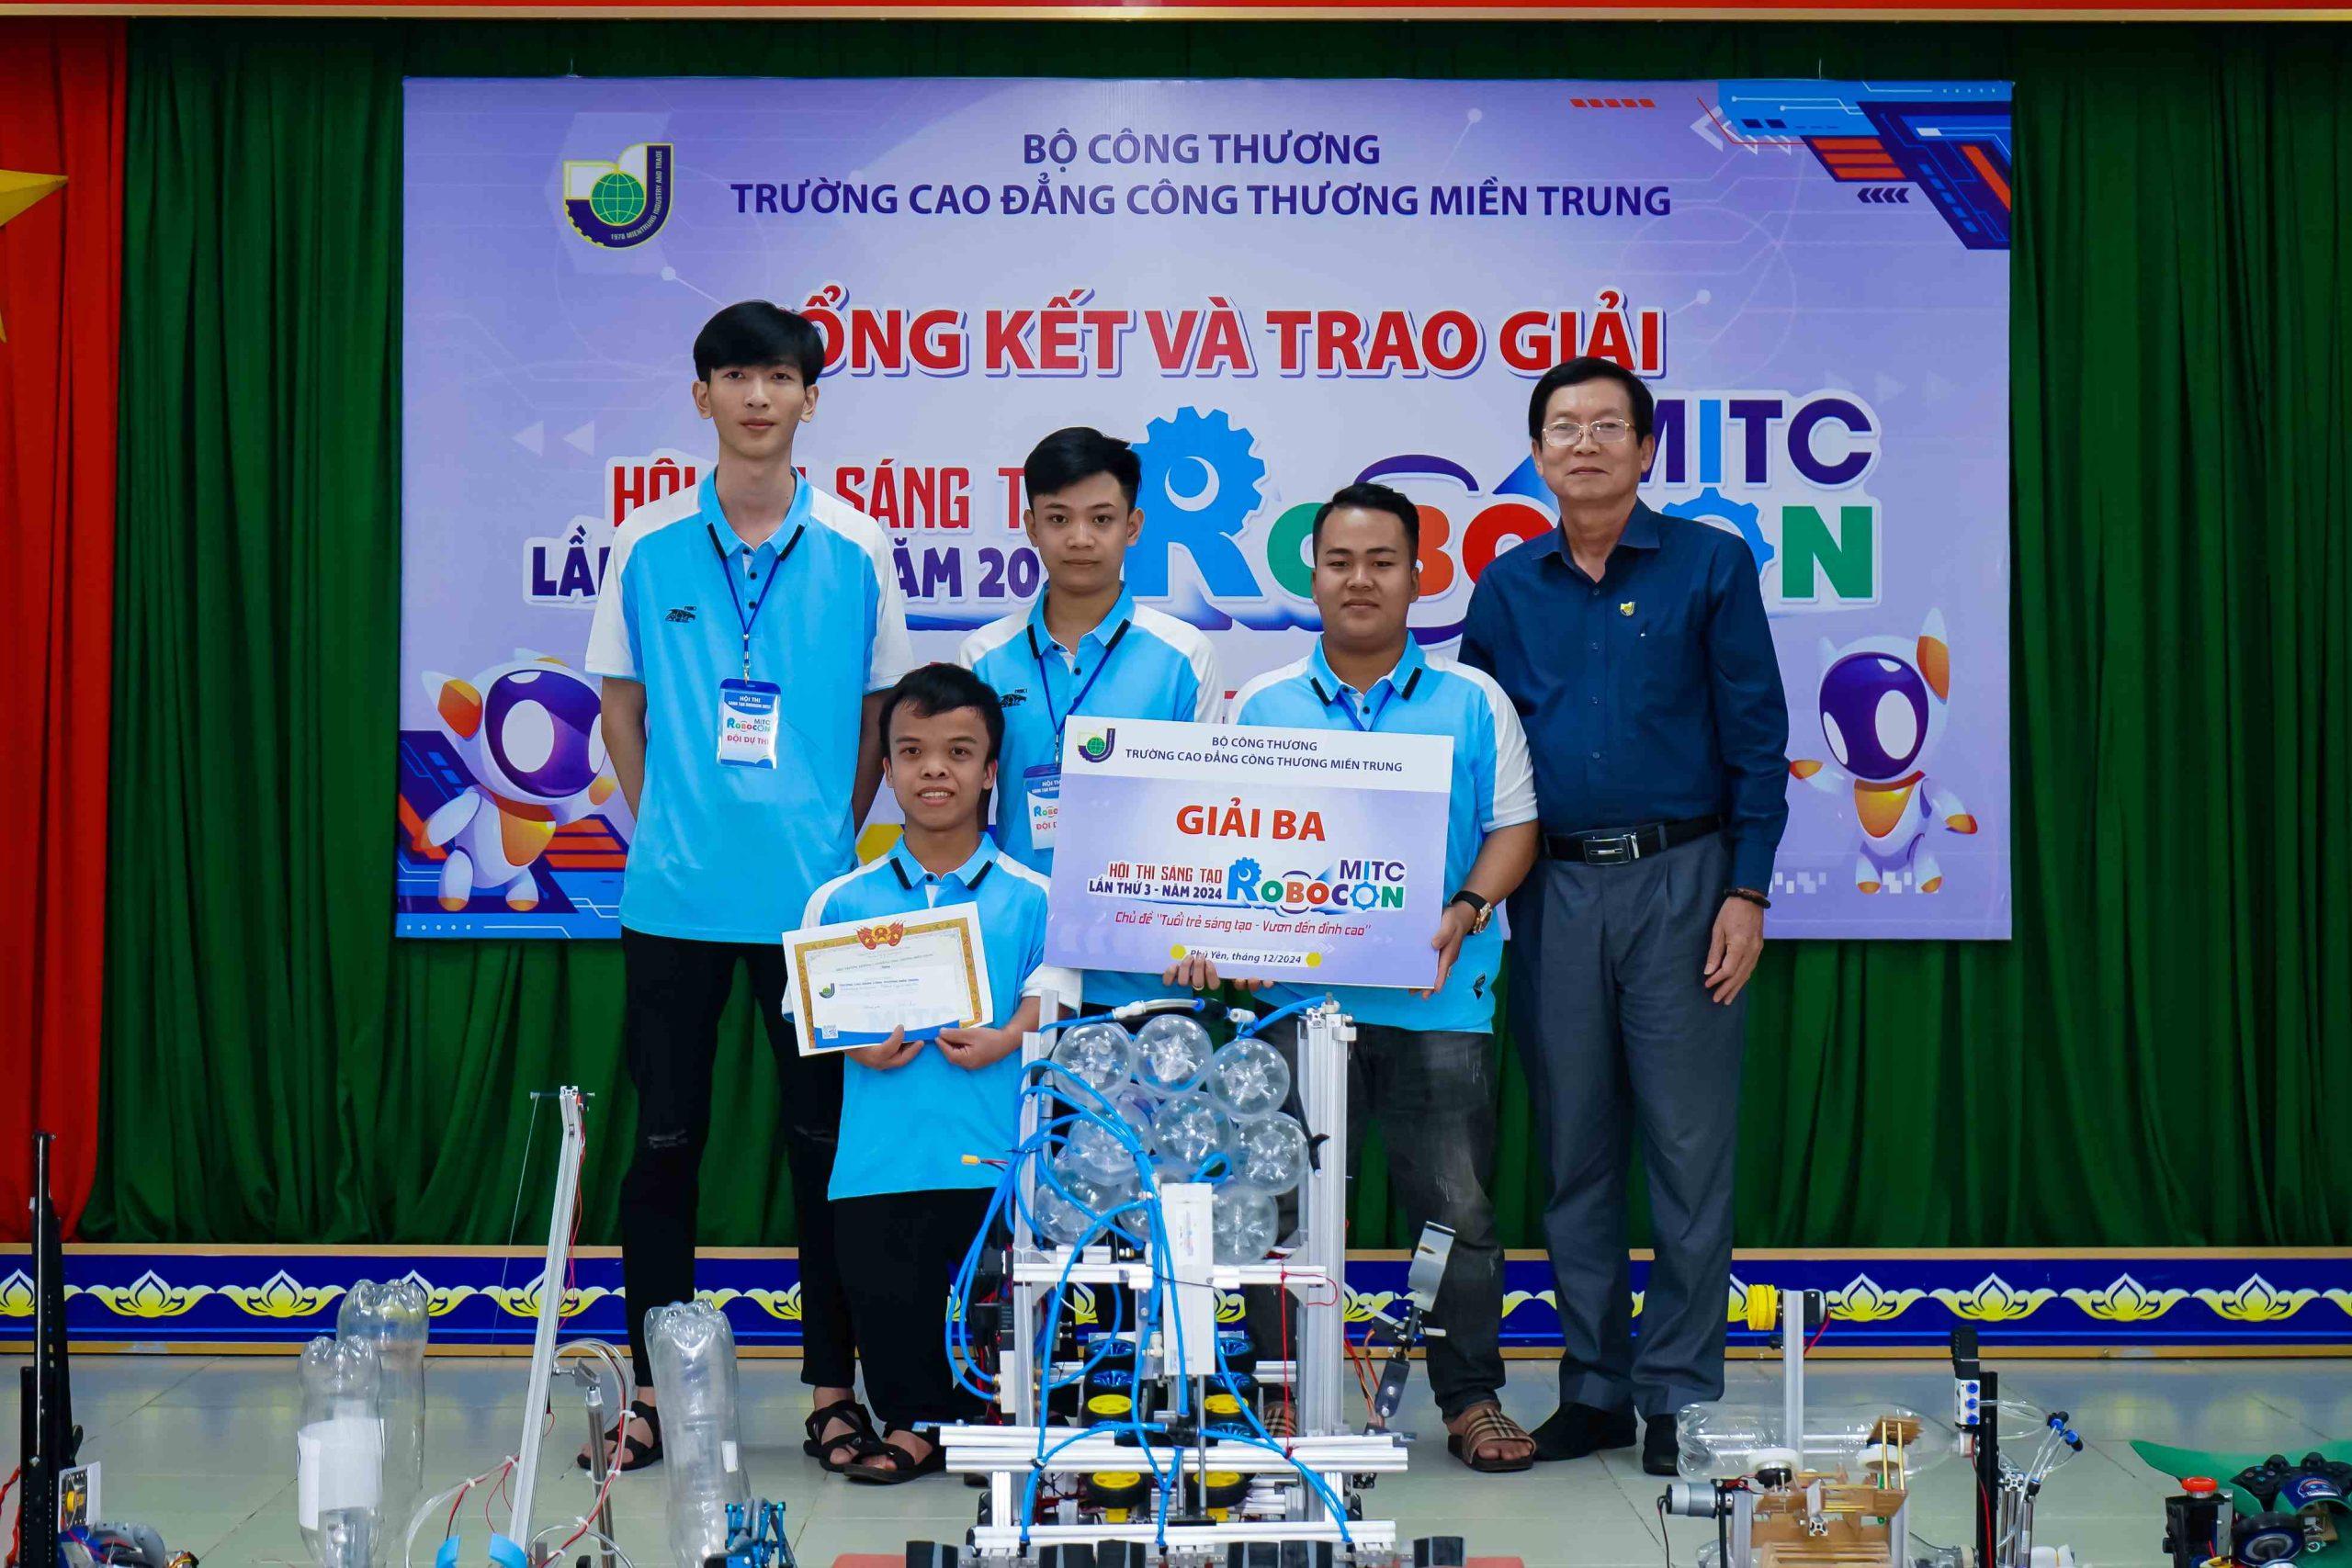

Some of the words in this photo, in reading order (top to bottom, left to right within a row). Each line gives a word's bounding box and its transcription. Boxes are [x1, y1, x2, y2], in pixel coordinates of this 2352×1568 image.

[1023, 127, 1078, 174] BỘ
[1088, 127, 1200, 164] CÔNG
[1208, 129, 1380, 165] THƯƠNG
[730, 175, 899, 214] TRƯỜNG
[909, 183, 991, 215] CAO
[1000, 171, 1115, 216] ĐẲNG
[1126, 177, 1238, 216] CÔNG
[1247, 180, 1419, 217] THƯƠNG
[1430, 175, 1528, 217] MIỀN
[1536, 185, 1672, 218] TRUNG
[796, 284, 962, 371] ỔNG
[986, 288, 1128, 370] KẾT
[1144, 295, 1250, 370] VÀ
[1266, 309, 1479, 372] TRAO
[1498, 289, 1658, 372] GIẢI
[836, 458, 970, 529] SÁNG
[532, 525, 612, 598] LẦ
[891, 536, 963, 598] ĂM
[978, 547, 1040, 598] 20
[1212, 736, 1228, 750] BỘ
[1231, 738, 1264, 749] CÔNG
[1267, 739, 1317, 751] THƯƠNG
[1125, 749, 1174, 761] TRƯỜNG
[1177, 751, 1202, 761] CAO
[1241, 754, 1274, 766] CÔNG
[1277, 757, 1328, 769] THƯƠNG
[1363, 761, 1403, 773] TRUNG
[1176, 796, 1261, 838] GIẢI
[1272, 809, 1326, 841] BA
[1109, 862, 1129, 880] HỘI
[1136, 864, 1155, 880] THI
[1160, 864, 1193, 882] SÁNG
[1200, 868, 1223, 886] TẠO
[1340, 859, 1406, 882] MITC
[1089, 876, 1114, 894] LẦN
[1117, 880, 1142, 895] THỨ
[1144, 885, 1151, 895] 3
[1161, 883, 1190, 897] NĂM
[1193, 886, 1222, 900] 2024
[1115, 910, 1136, 923] Chủ
[1139, 911, 1154, 925] đề
[1204, 917, 1231, 932] sáng
[1235, 919, 1252, 933] tạo
[1295, 919, 1316, 934] đến
[1211, 950, 1229, 961] Yên,
[1232, 952, 1260, 964] tháng
[1263, 953, 1301, 964] 12/2024
